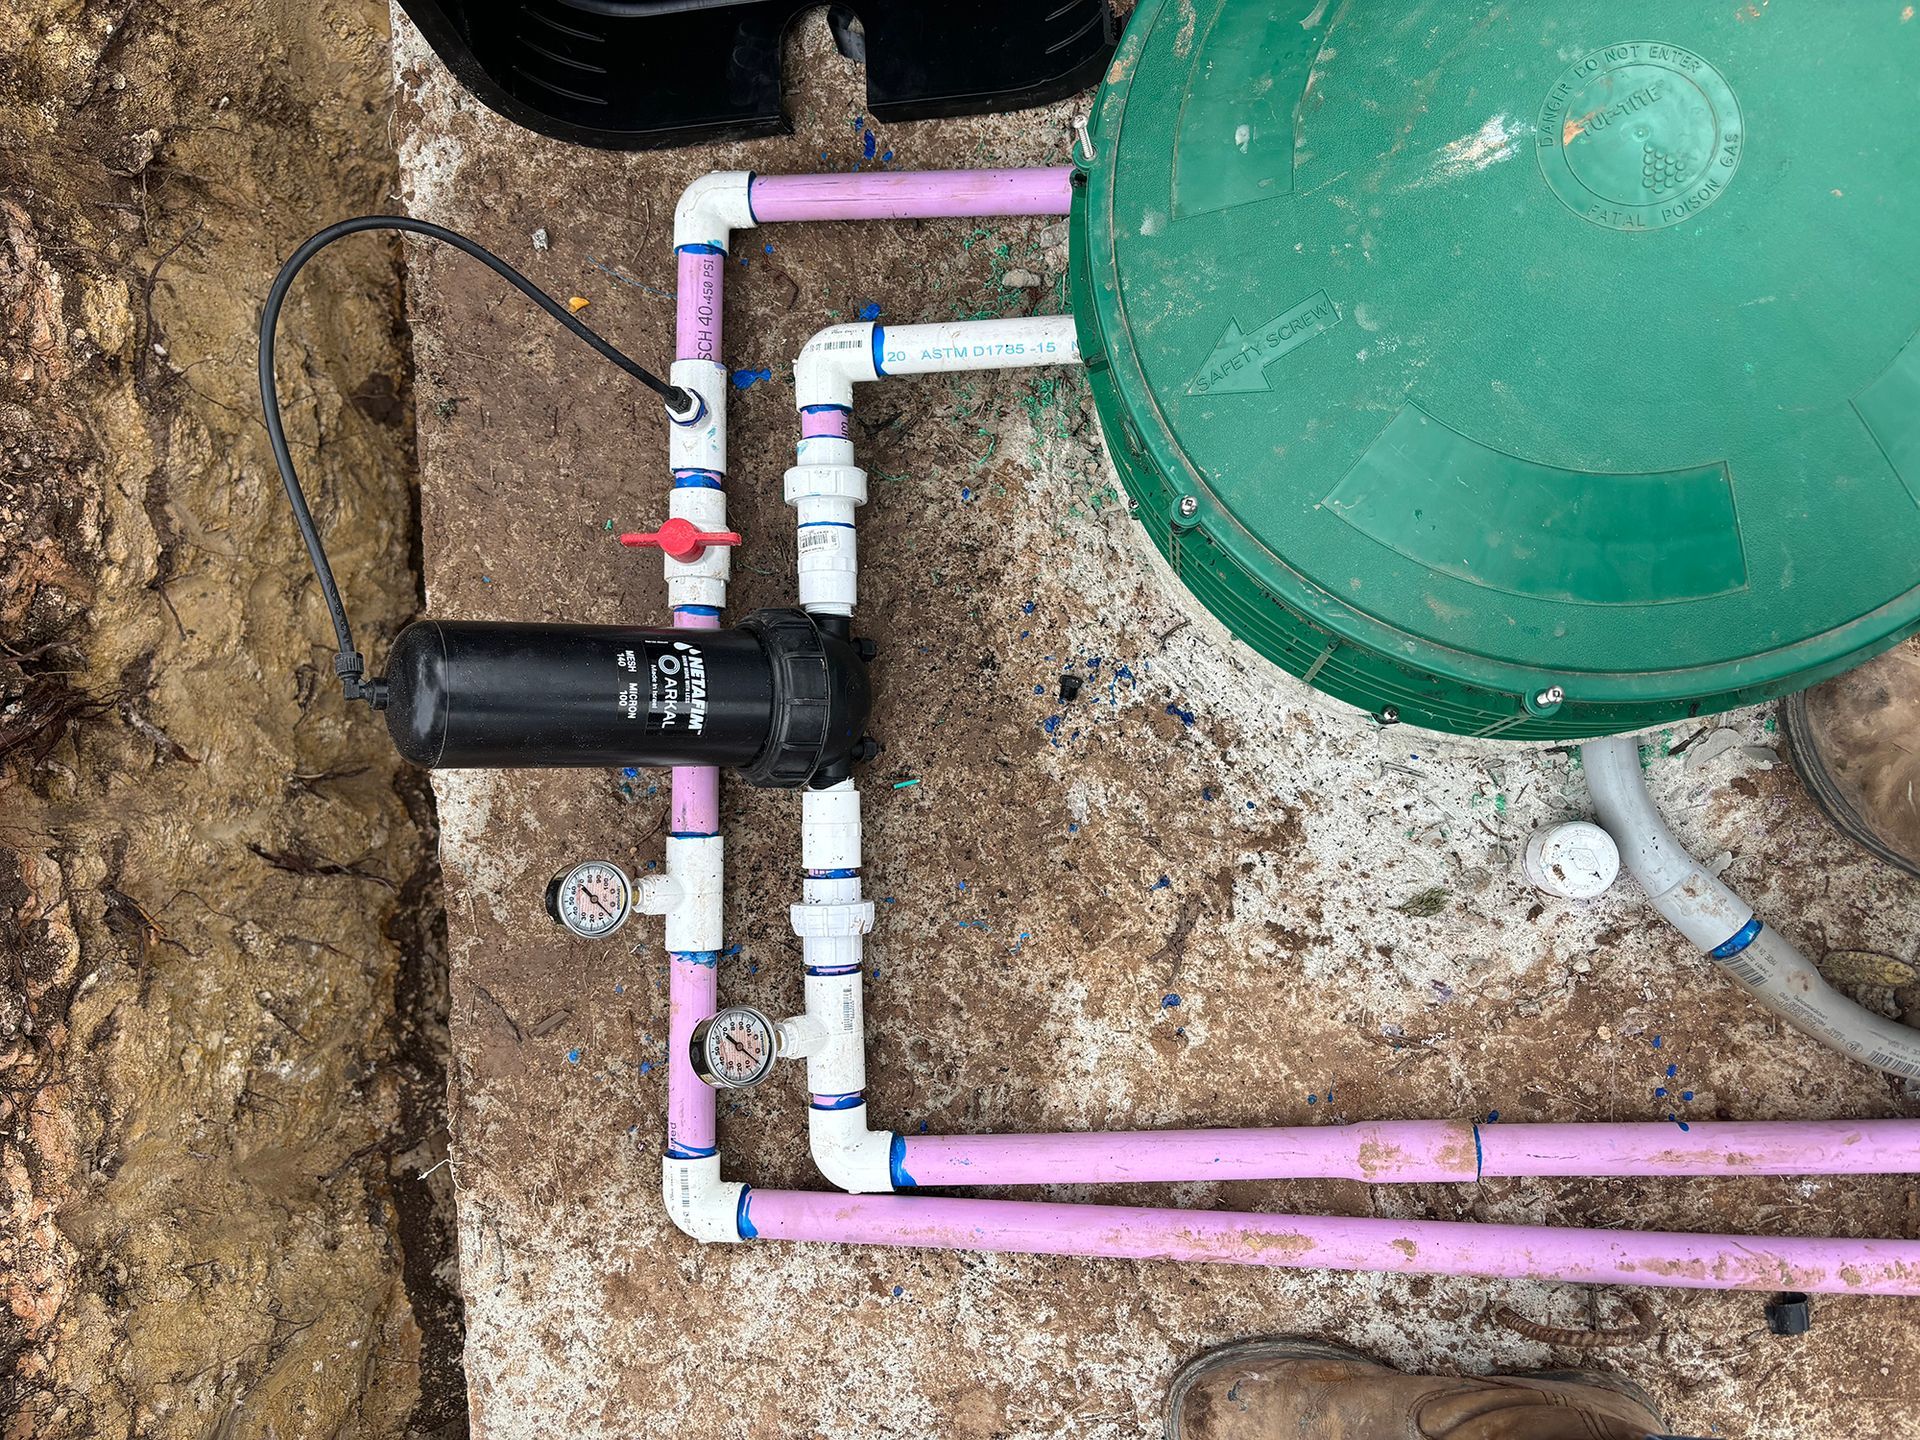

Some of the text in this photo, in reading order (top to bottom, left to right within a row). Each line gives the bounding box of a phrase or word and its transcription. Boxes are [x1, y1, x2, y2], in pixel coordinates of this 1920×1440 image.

[1540, 45, 1702, 148] DANGER DO NOT ENTER
[1586, 133, 1740, 228] FATAL POISON GAS
[703, 259, 714, 278] PSI
[697, 330, 713, 361] SCH
[887, 350, 906, 362] 20
[920, 346, 968, 361] ASTM
[973, 343, 1025, 358] D1785
[1196, 300, 1330, 392] SAFETY SCREW
[616, 652, 628, 707] 140 100
[625, 650, 638, 719] MESH MICRON
[662, 677, 678, 729] ARKAL
